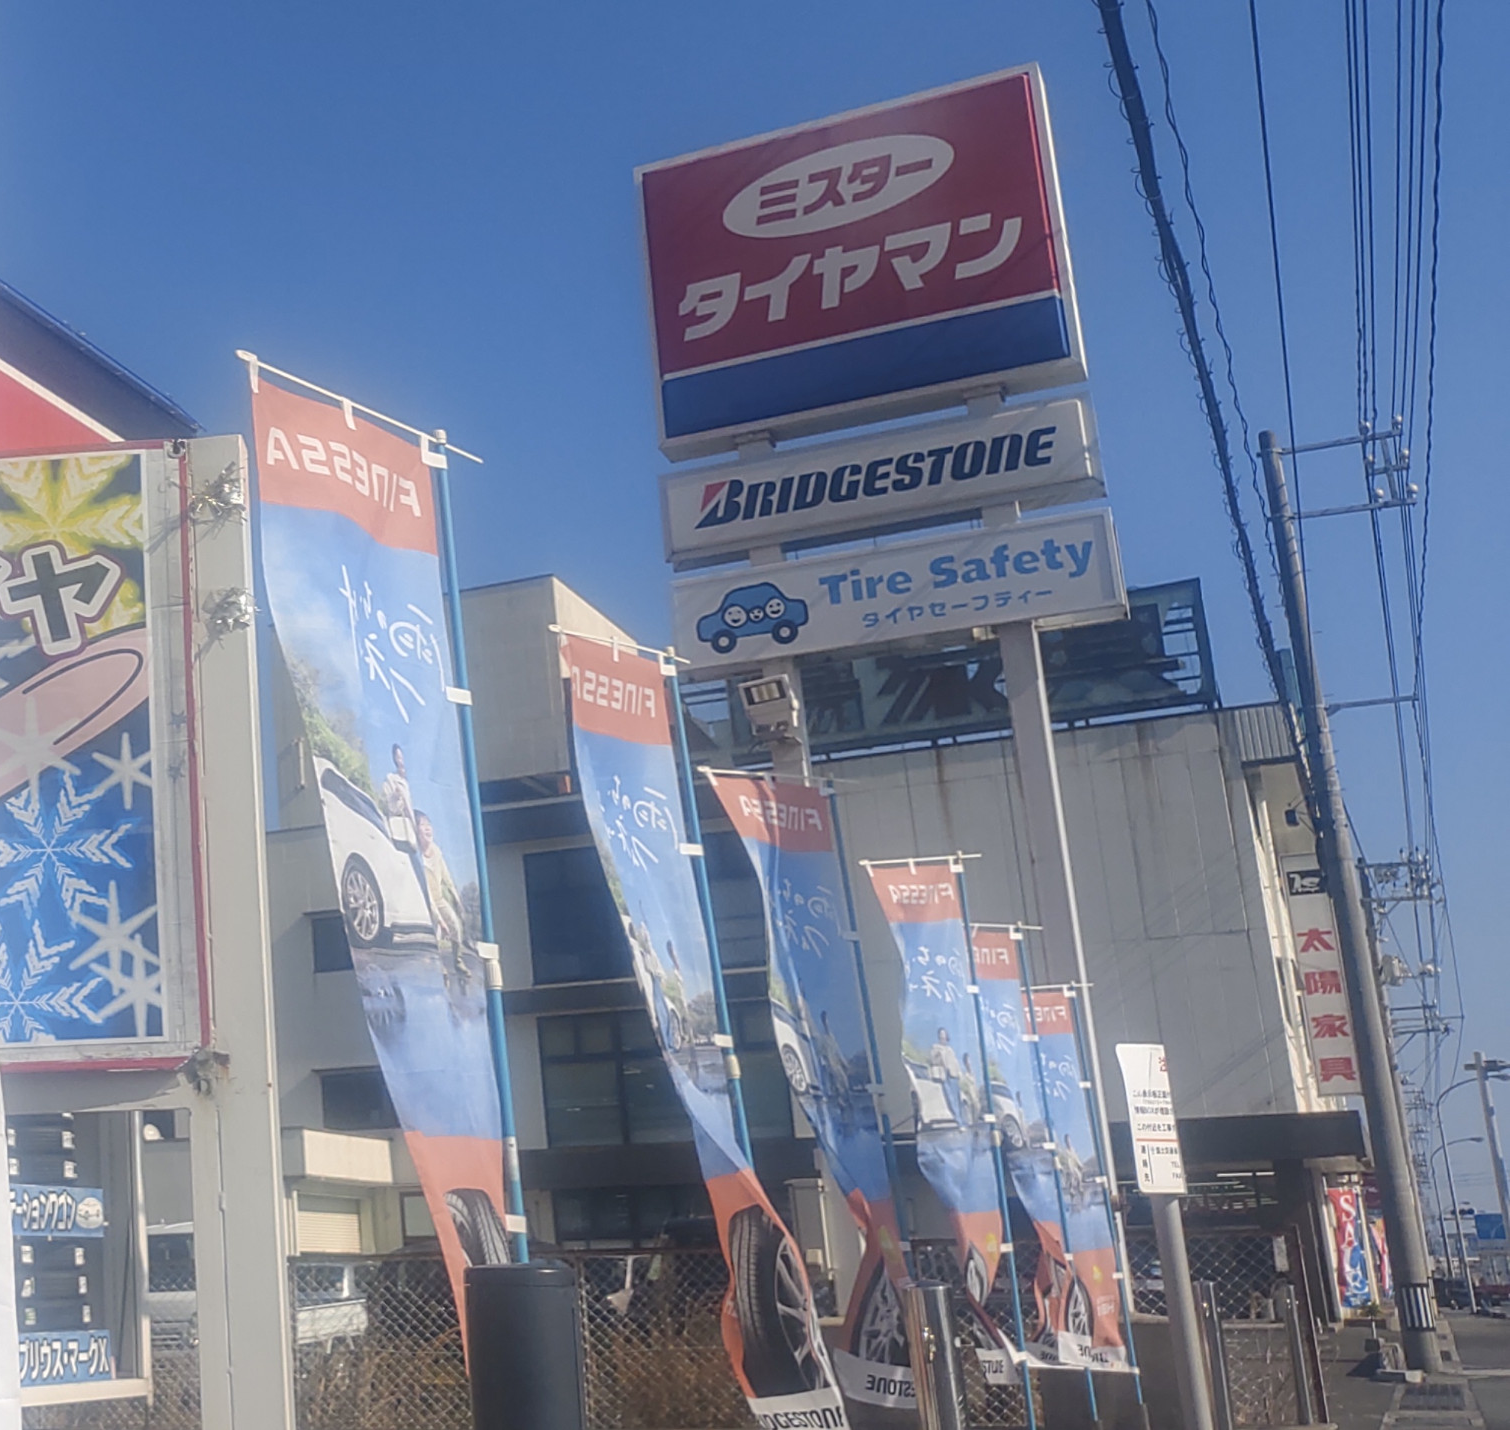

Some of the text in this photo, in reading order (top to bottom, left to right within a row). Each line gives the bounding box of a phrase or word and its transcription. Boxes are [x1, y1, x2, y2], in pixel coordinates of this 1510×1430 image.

[755, 153, 934, 226] ミスター
[678, 212, 1023, 342] タイヤマン
[694, 425, 1057, 530] BRIDGESTONE
[819, 537, 1094, 606] Tire Safety
[862, 588, 1054, 629] タイヤセーフティー
[1297, 928, 1357, 1082] 太陽家具
